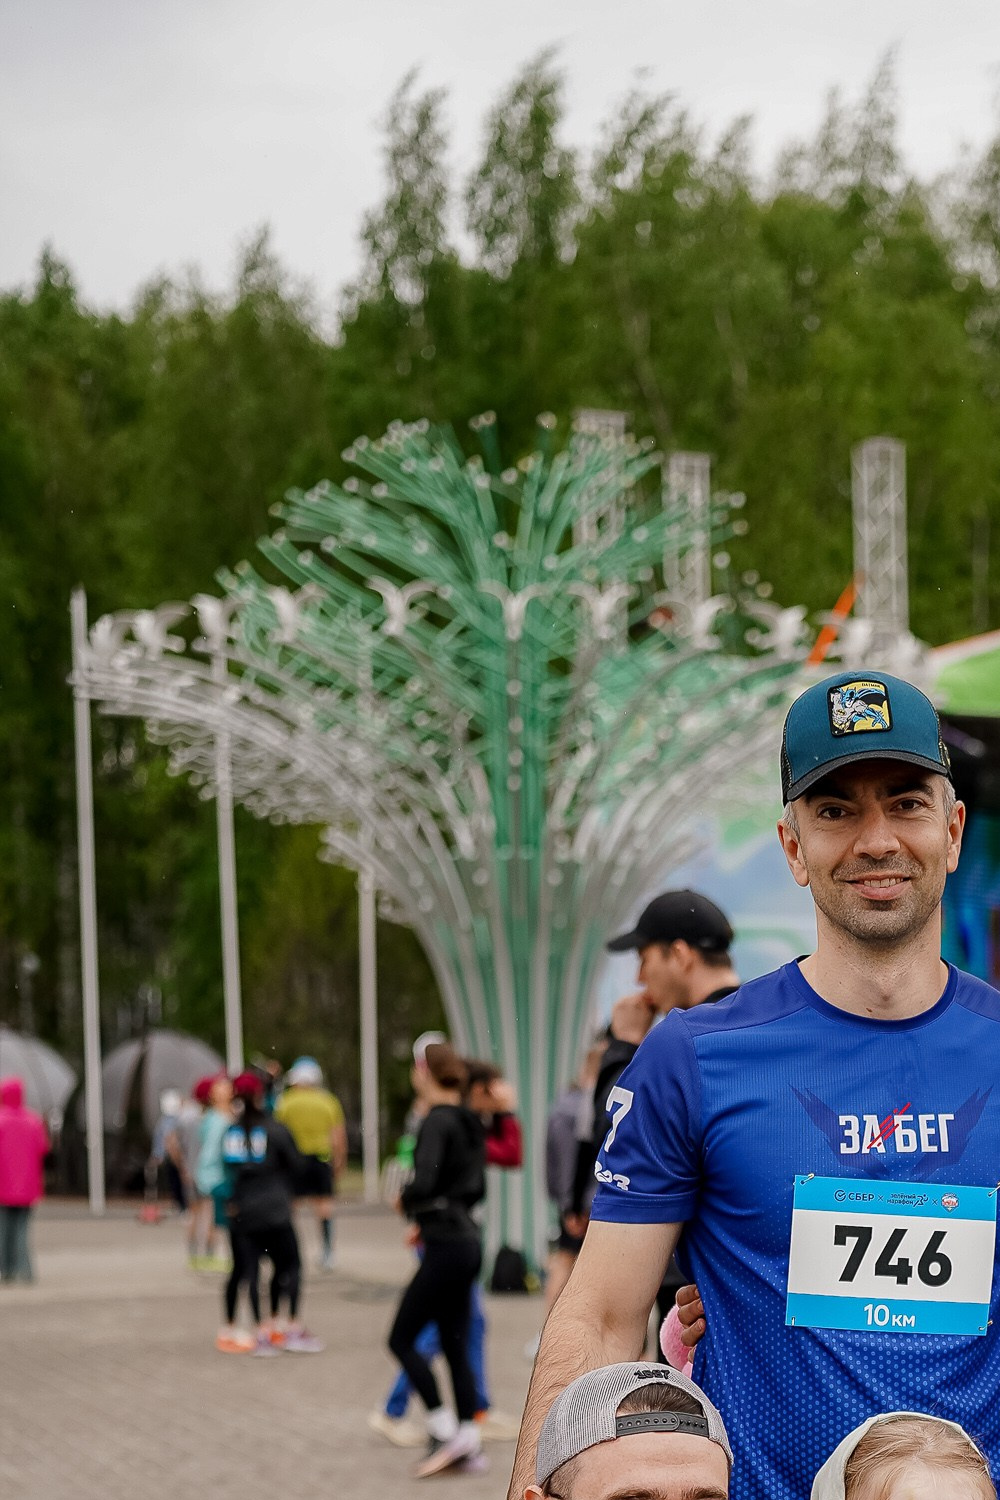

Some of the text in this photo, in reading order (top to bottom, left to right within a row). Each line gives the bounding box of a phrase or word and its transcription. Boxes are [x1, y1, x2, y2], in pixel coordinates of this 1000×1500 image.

[606, 1086, 634, 1152] 7
[838, 1113, 954, 1154] ЗАБЕГ
[848, 1192, 875, 1201] СБЕР
[834, 1225, 952, 1287] 746
[863, 1303, 890, 1327] 10
